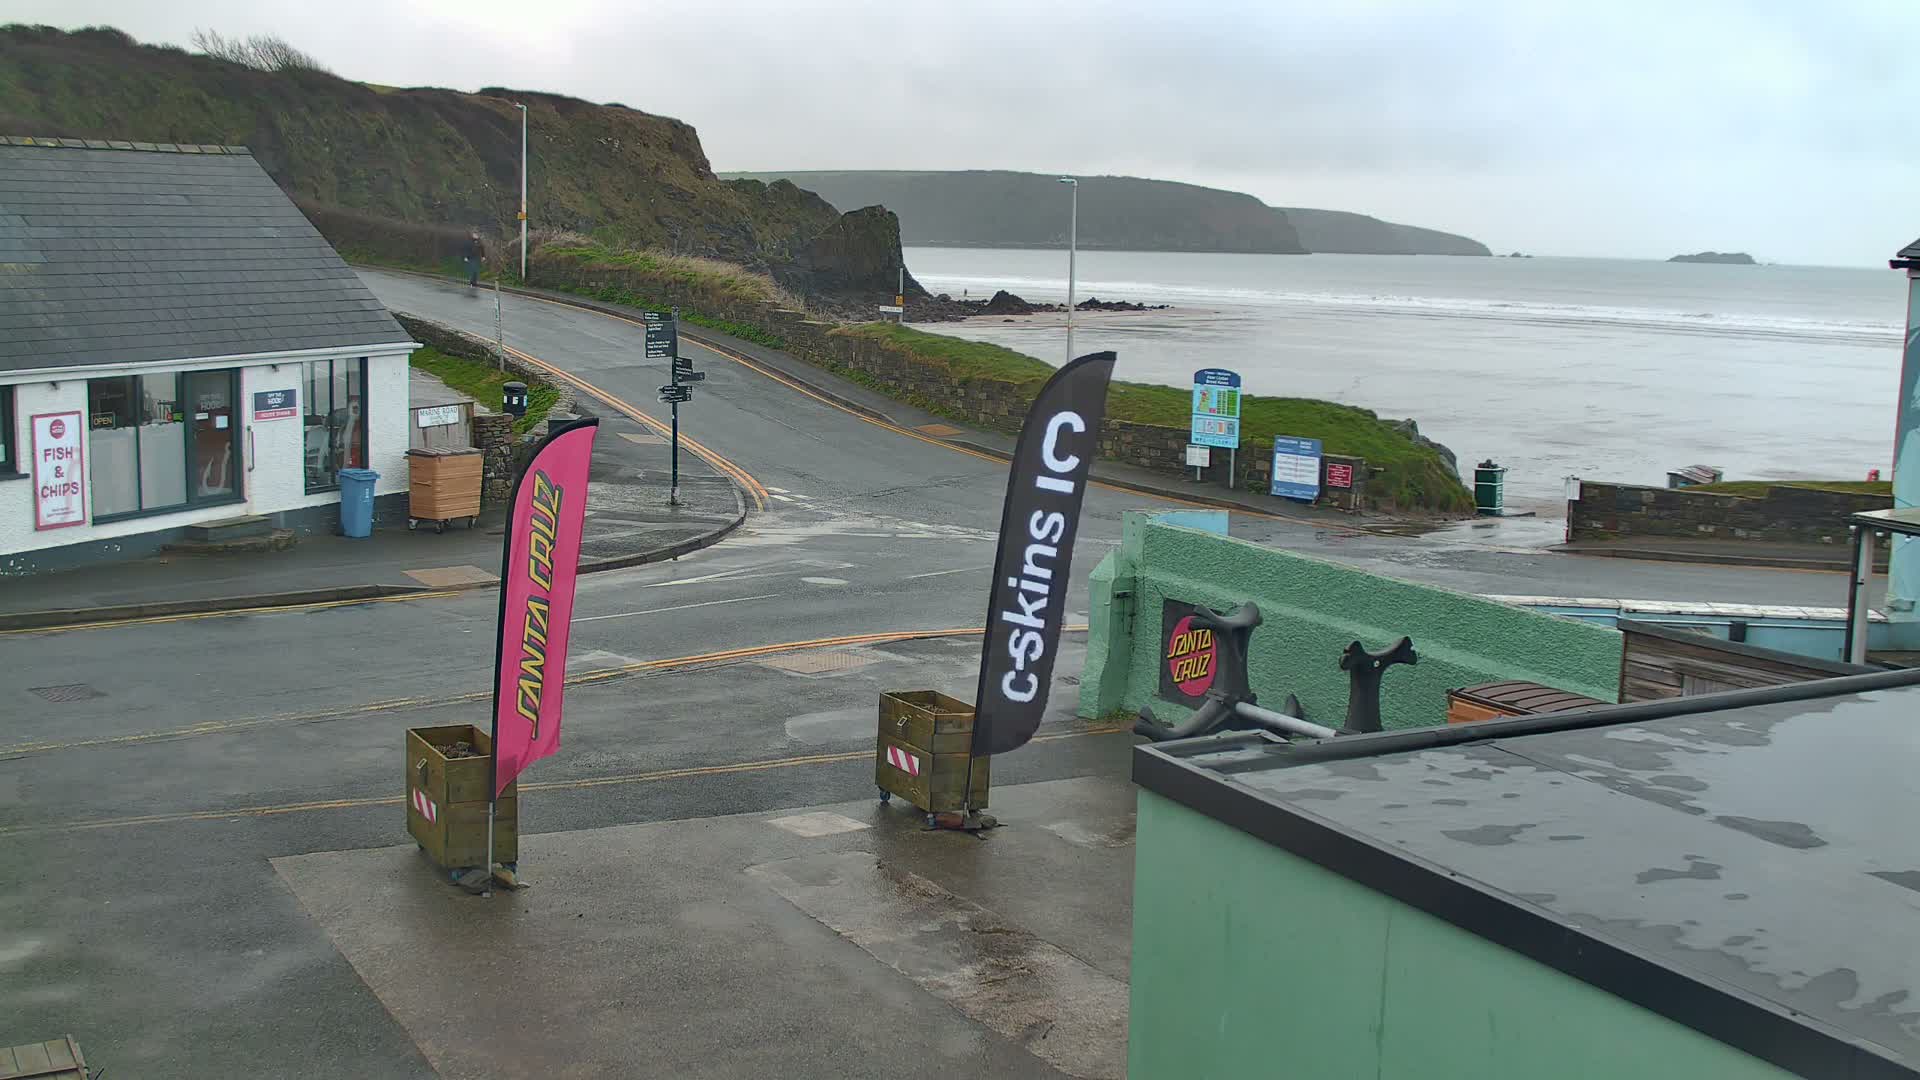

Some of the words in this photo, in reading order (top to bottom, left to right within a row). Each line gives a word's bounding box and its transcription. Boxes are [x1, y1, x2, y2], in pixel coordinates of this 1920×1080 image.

[420, 408, 441, 416] MARINE
[442, 407, 458, 415] ROAD
[93, 417, 113, 426] OPEN
[44, 446, 73, 463] FISH
[54, 466, 65, 479] &
[41, 482, 80, 499] CHIPS
[528, 469, 563, 593] CRUZ
[1167, 629, 1212, 659] SANTA
[516, 594, 550, 740] SANTA
[1173, 653, 1211, 683] CRUZ
